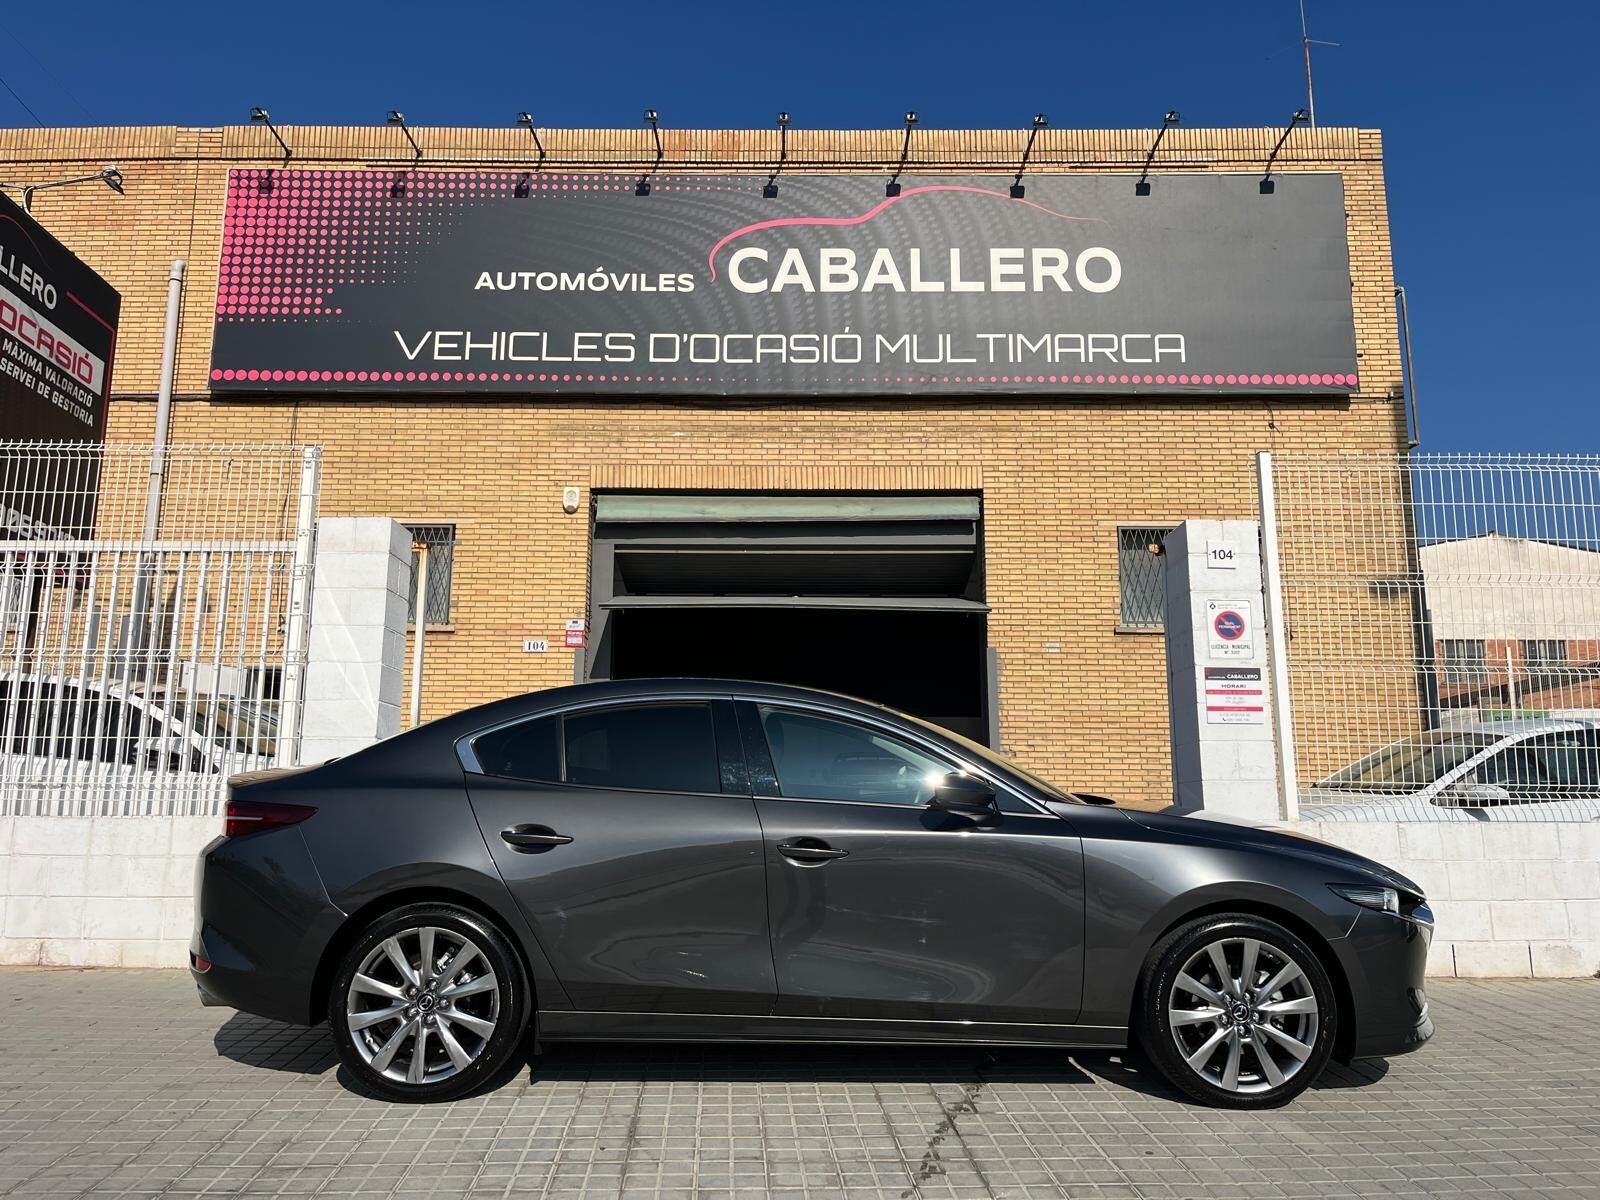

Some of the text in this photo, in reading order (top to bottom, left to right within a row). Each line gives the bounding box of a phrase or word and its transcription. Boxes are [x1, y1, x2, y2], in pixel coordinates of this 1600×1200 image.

[473, 246, 1123, 294] AUTOMÓVILES CABALLERO
[393, 325, 1187, 364] VEHICLES D'OCASIÓ MULTIMARCA
[0, 357, 94, 427] SERVEI DE GESTORIA
[2, 337, 93, 408] MÀXIMA VALORACIÓ
[1211, 549, 1233, 560] 104
[527, 641, 545, 651] 104
